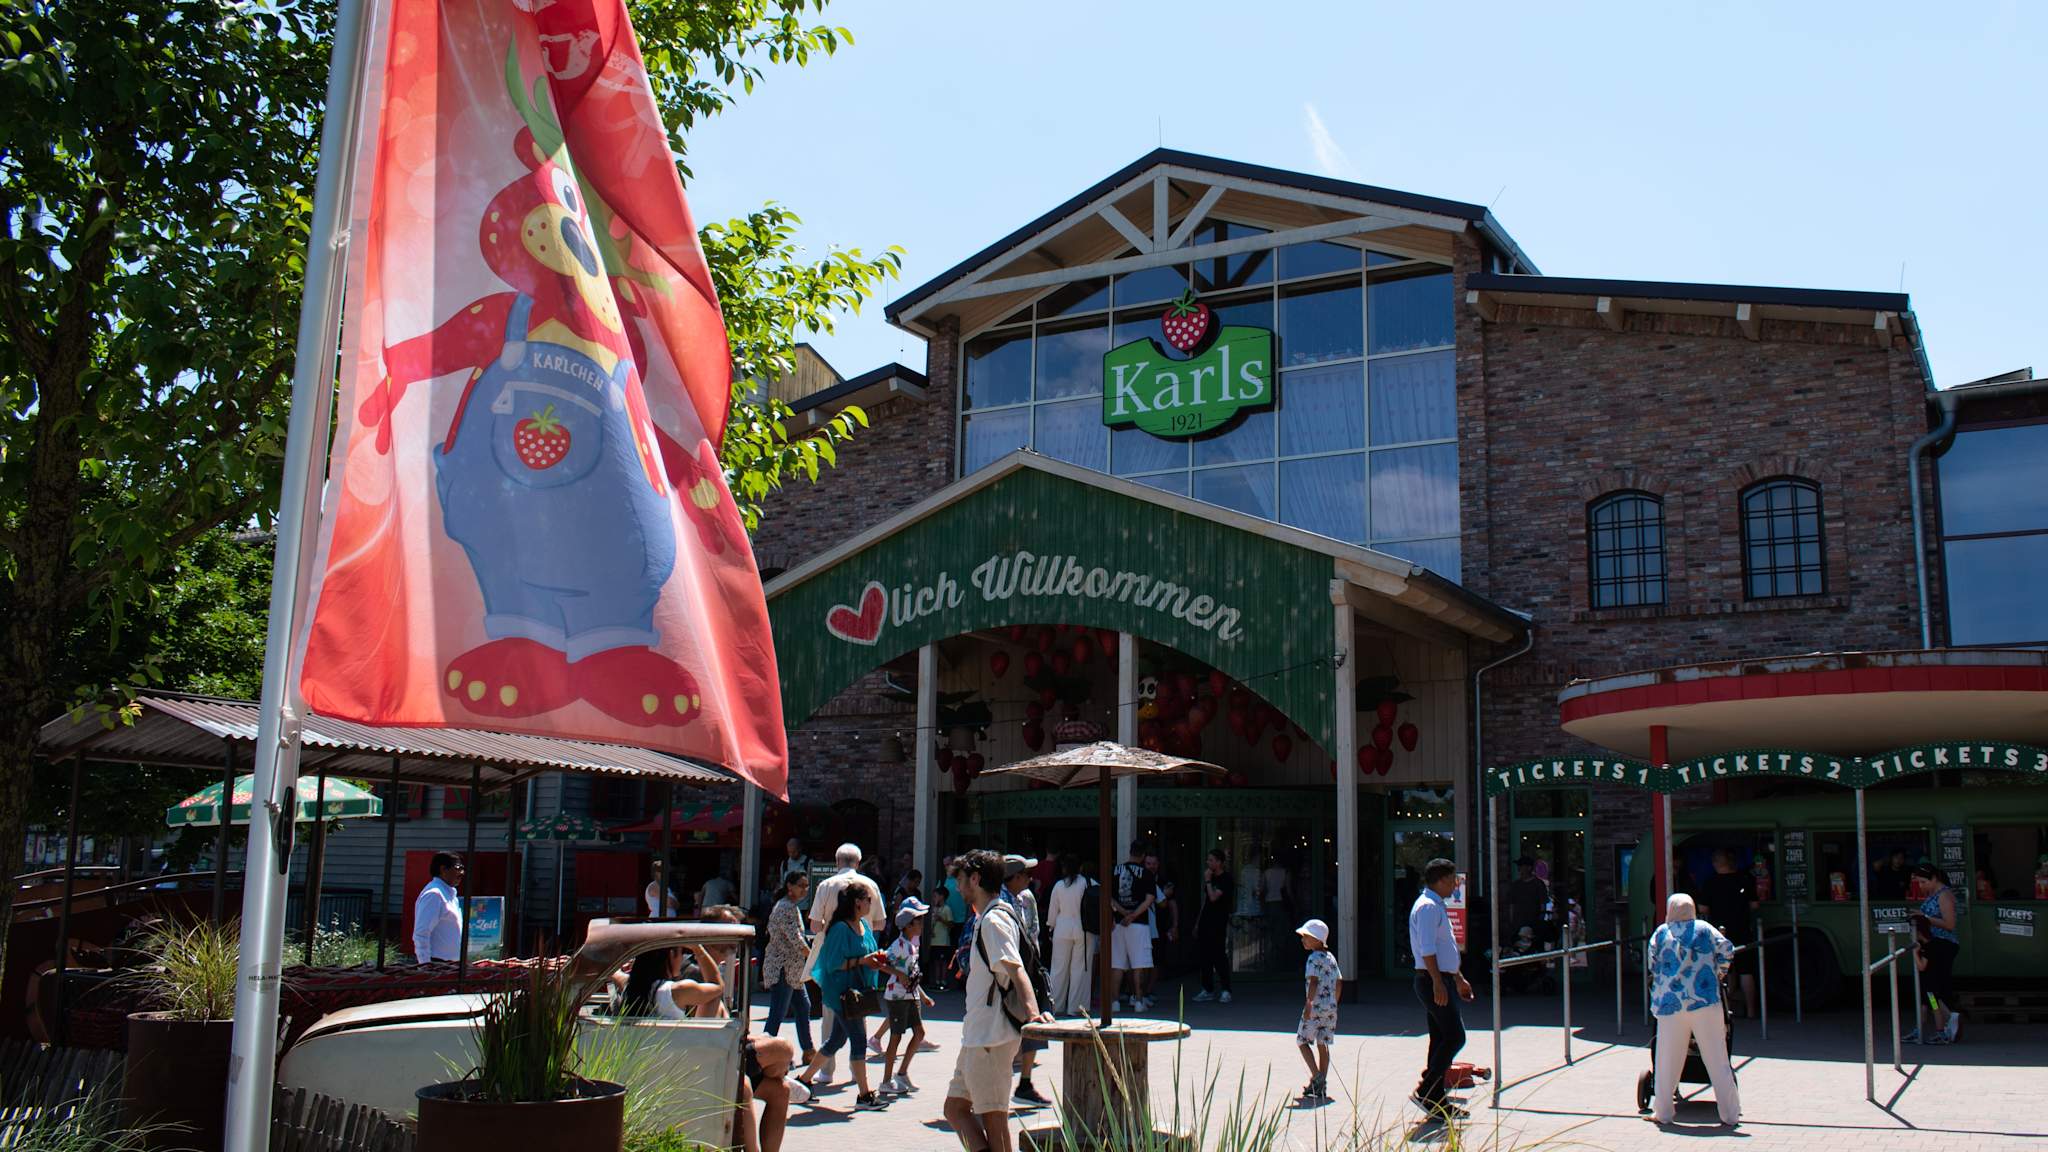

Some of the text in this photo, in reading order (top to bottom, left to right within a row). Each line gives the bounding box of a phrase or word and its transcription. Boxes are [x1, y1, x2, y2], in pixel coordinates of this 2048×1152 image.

[533, 352, 604, 393] KARLCHEN
[1111, 345, 1264, 416] Karls
[1171, 413, 1203, 432] 1921
[892, 551, 1243, 641] lich Willkommen
[1498, 760, 1649, 788] TICKETS 1
[1677, 754, 1841, 784] TICKETS 2
[1871, 746, 2048, 778] TICKETS 3
[1873, 907, 1907, 919] TICKETS
[1997, 907, 2033, 920] TICKETS
